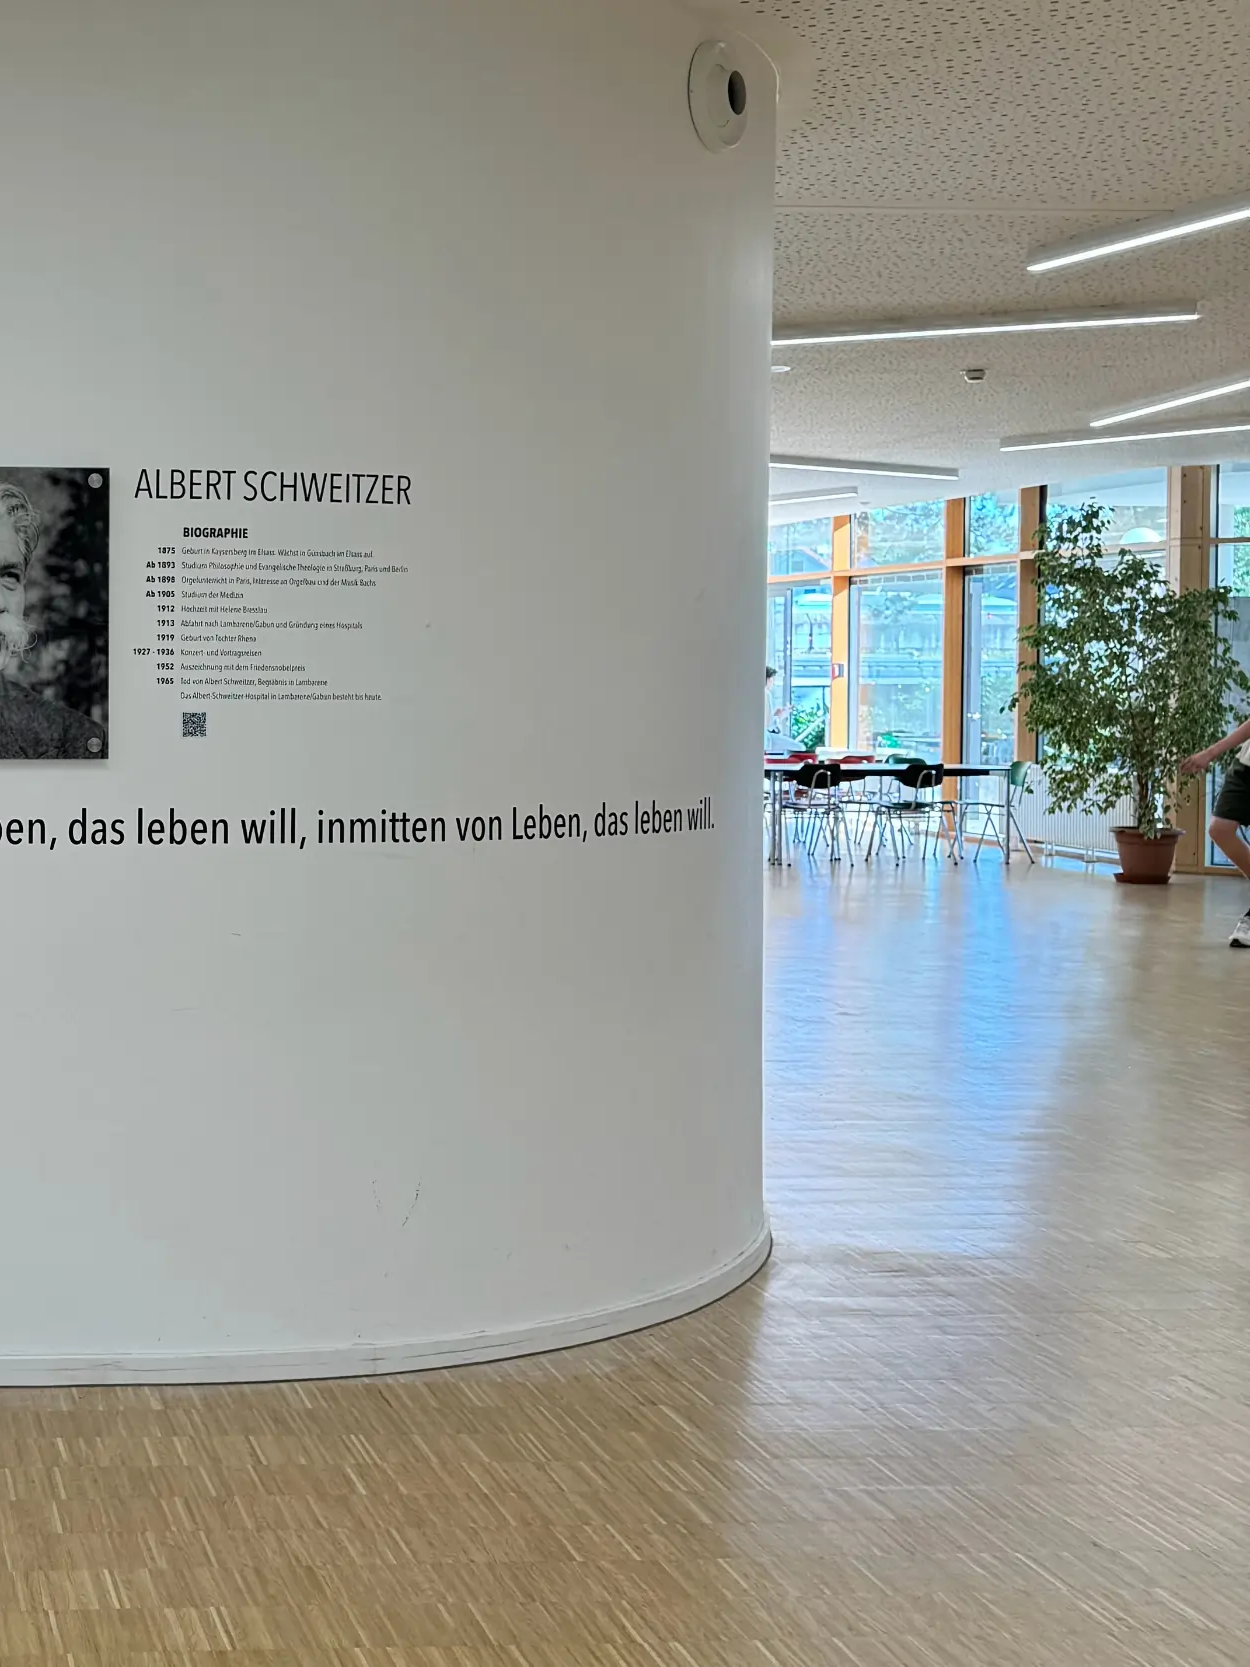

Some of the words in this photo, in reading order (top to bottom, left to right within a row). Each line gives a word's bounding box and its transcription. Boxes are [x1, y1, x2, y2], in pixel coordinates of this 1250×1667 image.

[134, 468, 237, 501] ALBERT
[243, 470, 412, 506] SCHWEITZER
[182, 526, 249, 539] BIOGRAPHIE
[158, 546, 176, 554] 1875
[182, 546, 203, 555] Geburt
[212, 548, 247, 558] Kaysersberg
[249, 548, 256, 556] im
[299, 549, 306, 557] in
[346, 550, 362, 558] Elsass
[182, 561, 208, 570] Studium
[209, 562, 244, 571] Philosophie
[246, 562, 257, 570] und
[258, 563, 296, 572] Evangelische
[297, 563, 326, 573] Theologie
[327, 564, 332, 572] in
[379, 565, 391, 573] und
[392, 565, 408, 573] Berlin
[182, 576, 227, 585] Orgelunterricht
[236, 577, 252, 585] Paris,
[253, 577, 279, 585] Interesse
[289, 578, 316, 587] Orgelbau
[317, 578, 328, 586] und
[330, 578, 340, 586] der
[359, 579, 377, 587] Bachs
[220, 591, 244, 599] Medizin
[181, 605, 208, 613] Hochzeit
[205, 620, 218, 628] nach
[289, 621, 318, 630] Gründung
[336, 622, 363, 630] Hospitals
[181, 634, 202, 642] Geburt
[215, 634, 237, 642] Tochter
[133, 648, 151, 656] 1927
[157, 648, 175, 656] 1936
[220, 649, 262, 658] Vortragsreisen
[180, 663, 222, 672] Auszeichnung
[235, 663, 249, 671] dem
[250, 664, 306, 672] Friedensnobelpreis
[156, 677, 174, 685] 1965
[180, 677, 191, 685] Tod
[224, 678, 257, 686] Schweitzer,
[257, 678, 287, 687] Begräbnis
[180, 692, 191, 700] Das
[68, 807, 125, 846] das
[137, 807, 229, 846] leben
[241, 807, 307, 850] will,
[318, 808, 446, 844] inmitten
[456, 815, 503, 842] von
[512, 803, 588, 843] Leben,
[593, 801, 629, 838] das
[634, 799, 683, 835] leben
[687, 796, 715, 831] will.
